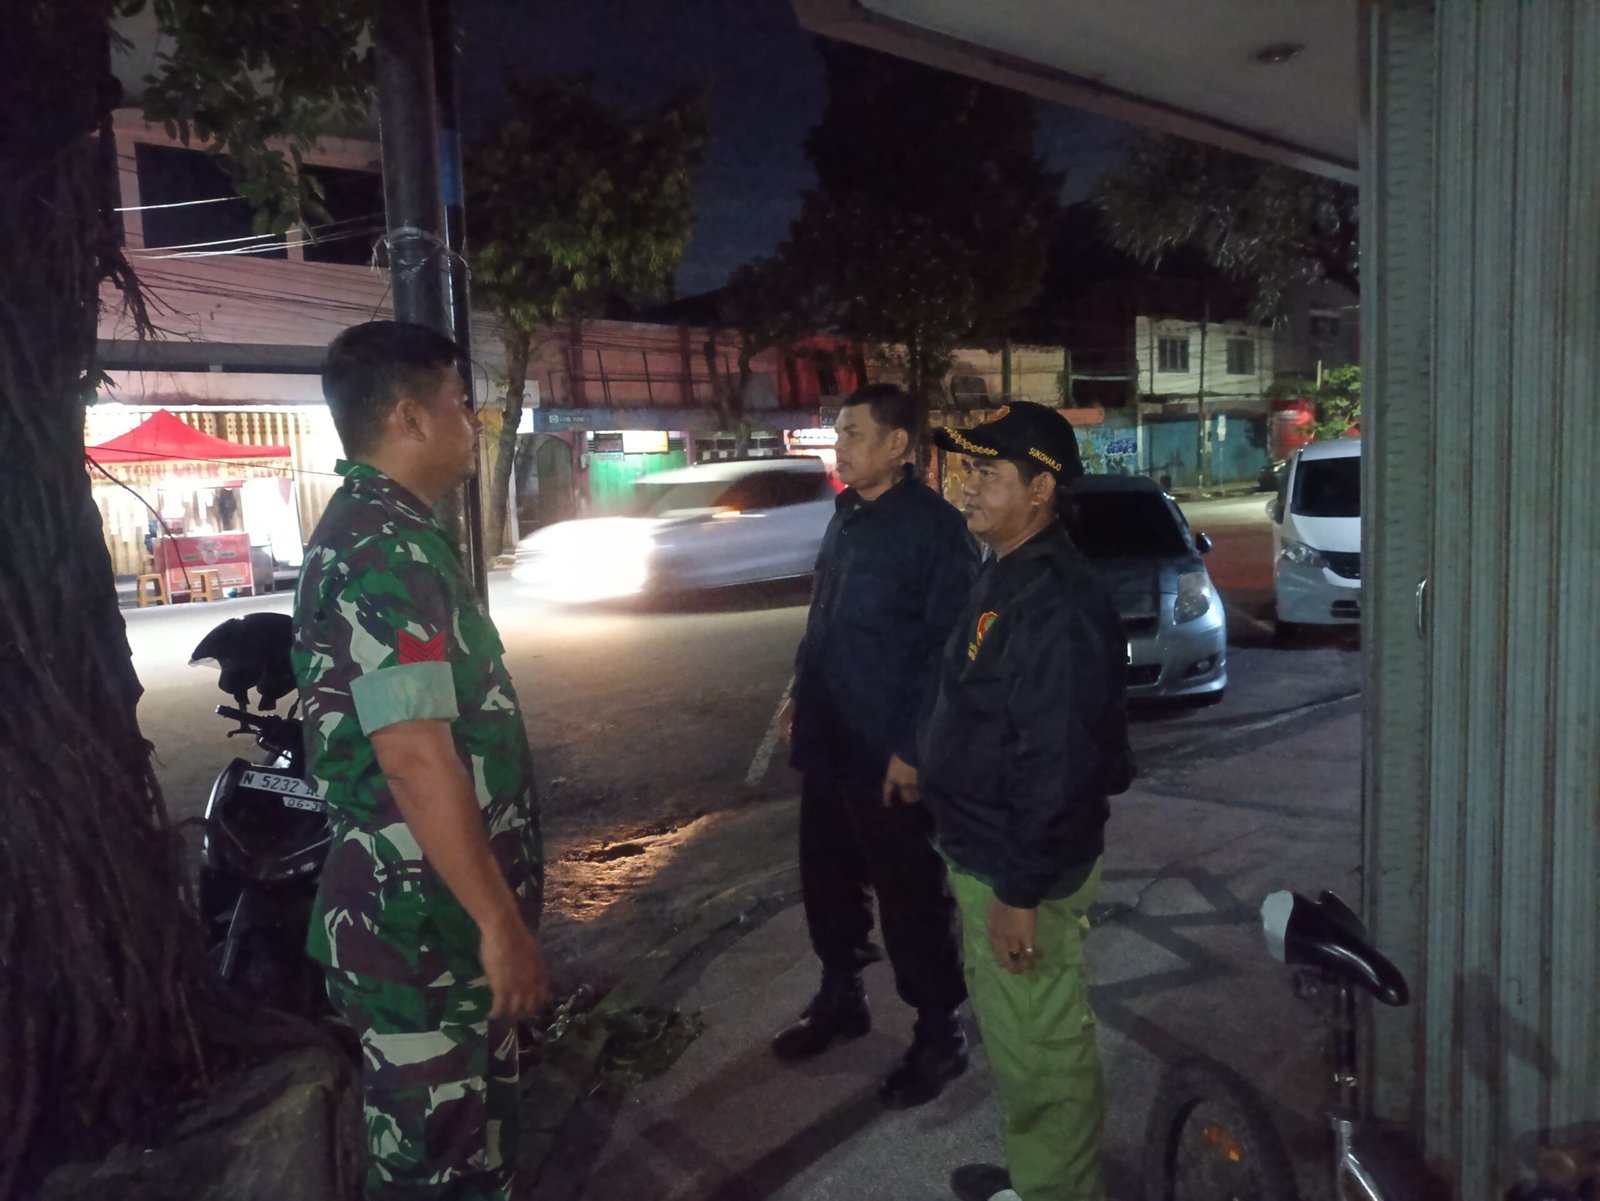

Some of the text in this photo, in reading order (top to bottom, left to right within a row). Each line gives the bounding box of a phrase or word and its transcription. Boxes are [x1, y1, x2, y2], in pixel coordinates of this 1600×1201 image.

[1028, 447, 1062, 471] SUKOHARJO
[242, 772, 255, 785] N
[261, 775, 300, 793] 5232
